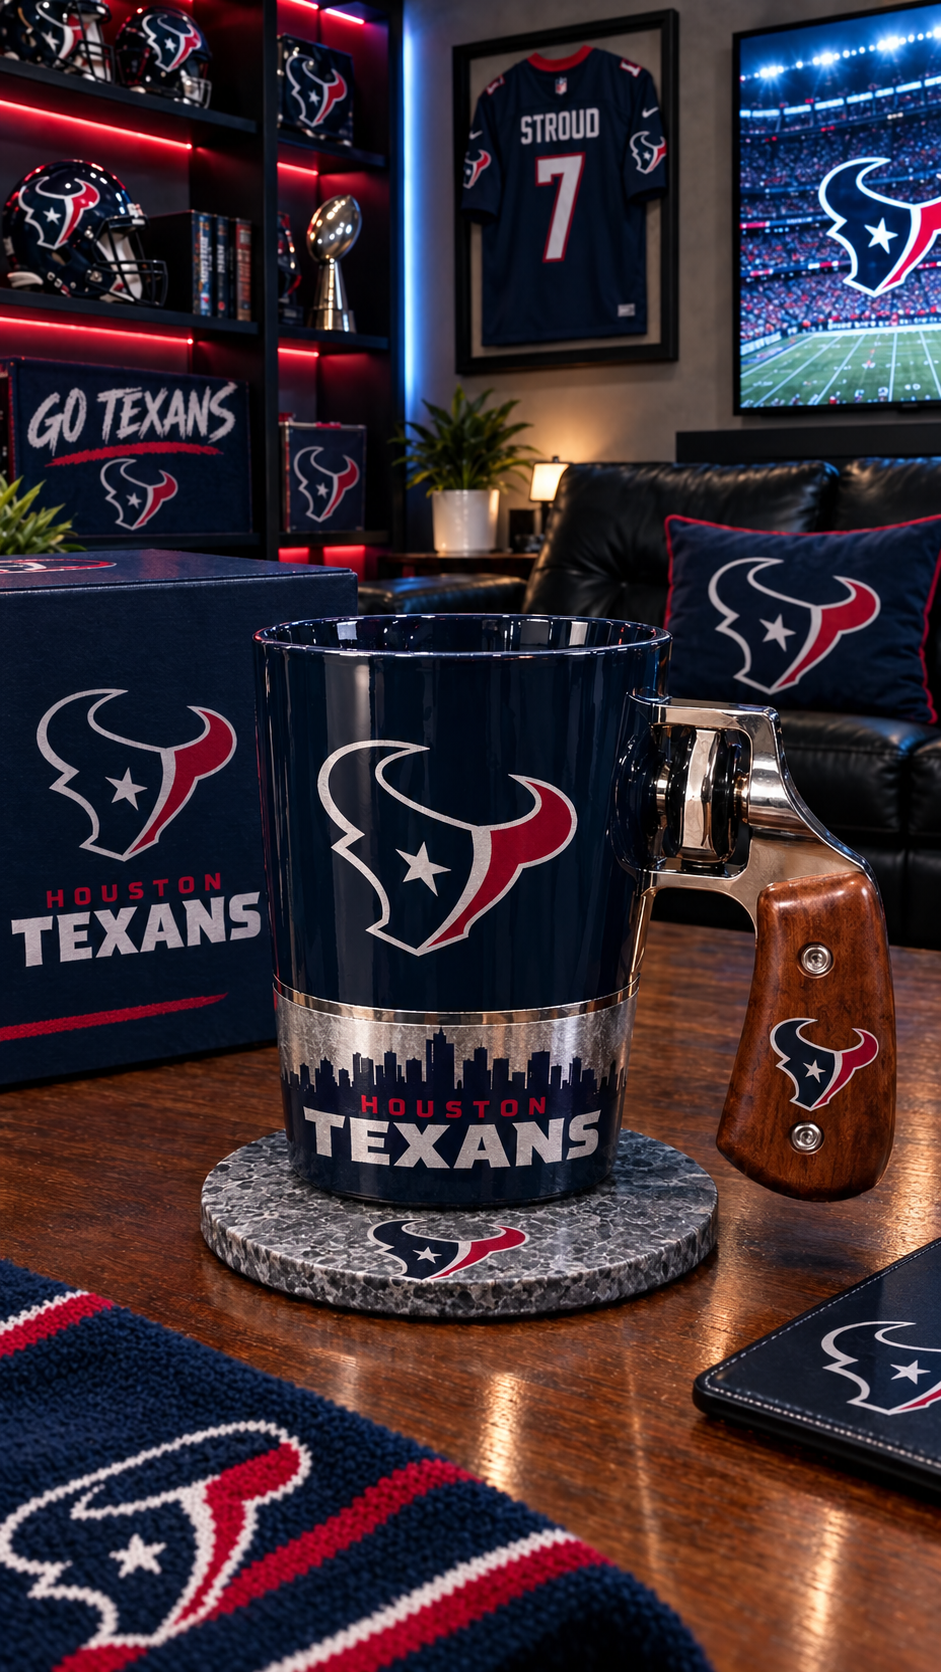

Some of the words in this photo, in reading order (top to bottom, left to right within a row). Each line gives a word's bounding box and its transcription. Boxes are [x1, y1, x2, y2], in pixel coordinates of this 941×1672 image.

[521, 107, 600, 145] STROUD
[535, 152, 585, 263] 7
[27, 387, 87, 453] GO
[97, 382, 237, 442] TEXANS
[46, 872, 221, 908] HOUSTON
[10, 891, 261, 968] TEXANS
[303, 1106, 601, 1169] TEXANS
[360, 1094, 546, 1118] HOUSTON
